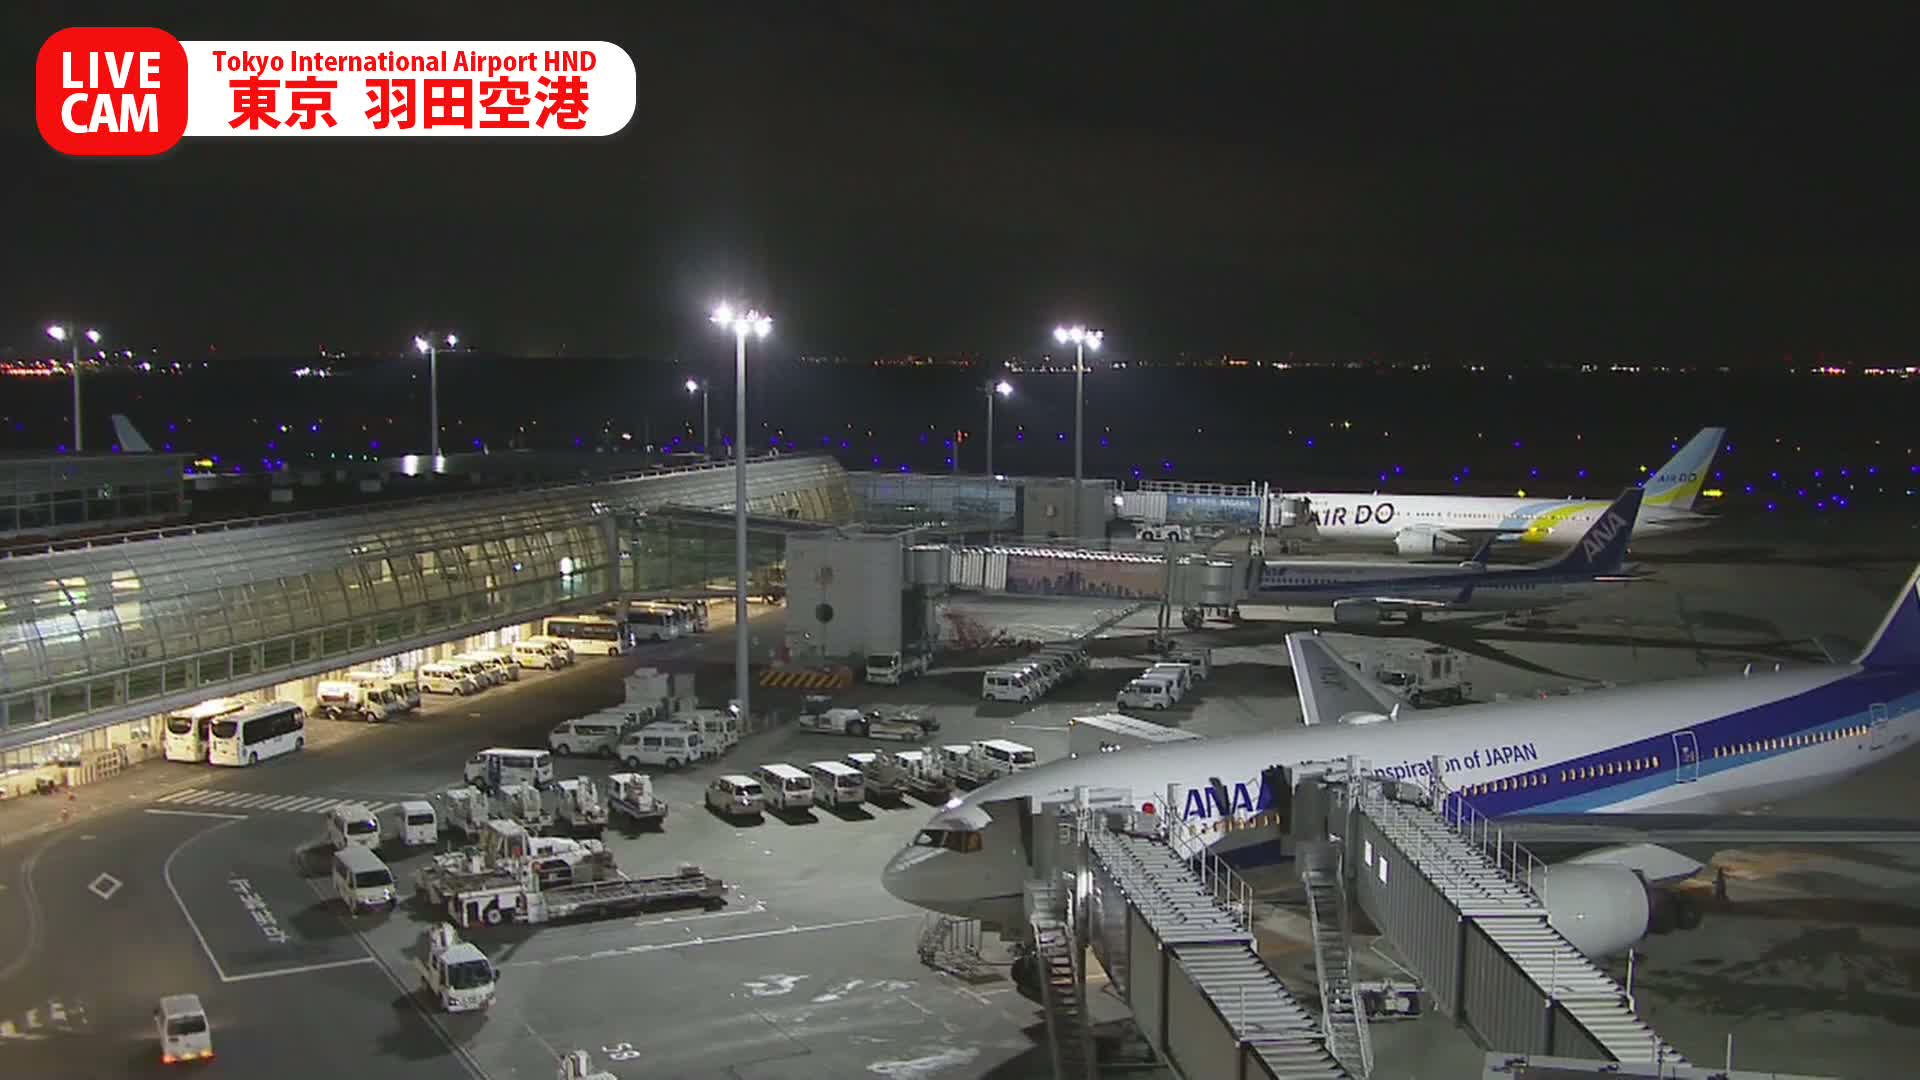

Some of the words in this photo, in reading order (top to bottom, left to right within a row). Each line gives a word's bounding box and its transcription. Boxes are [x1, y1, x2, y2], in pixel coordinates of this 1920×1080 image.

[1355, 503, 1394, 524] DO
[1583, 511, 1627, 563] ANA
[1464, 749, 1482, 770] of
[1485, 743, 1538, 767] JAPAN
[1183, 783, 1253, 821] ANA
